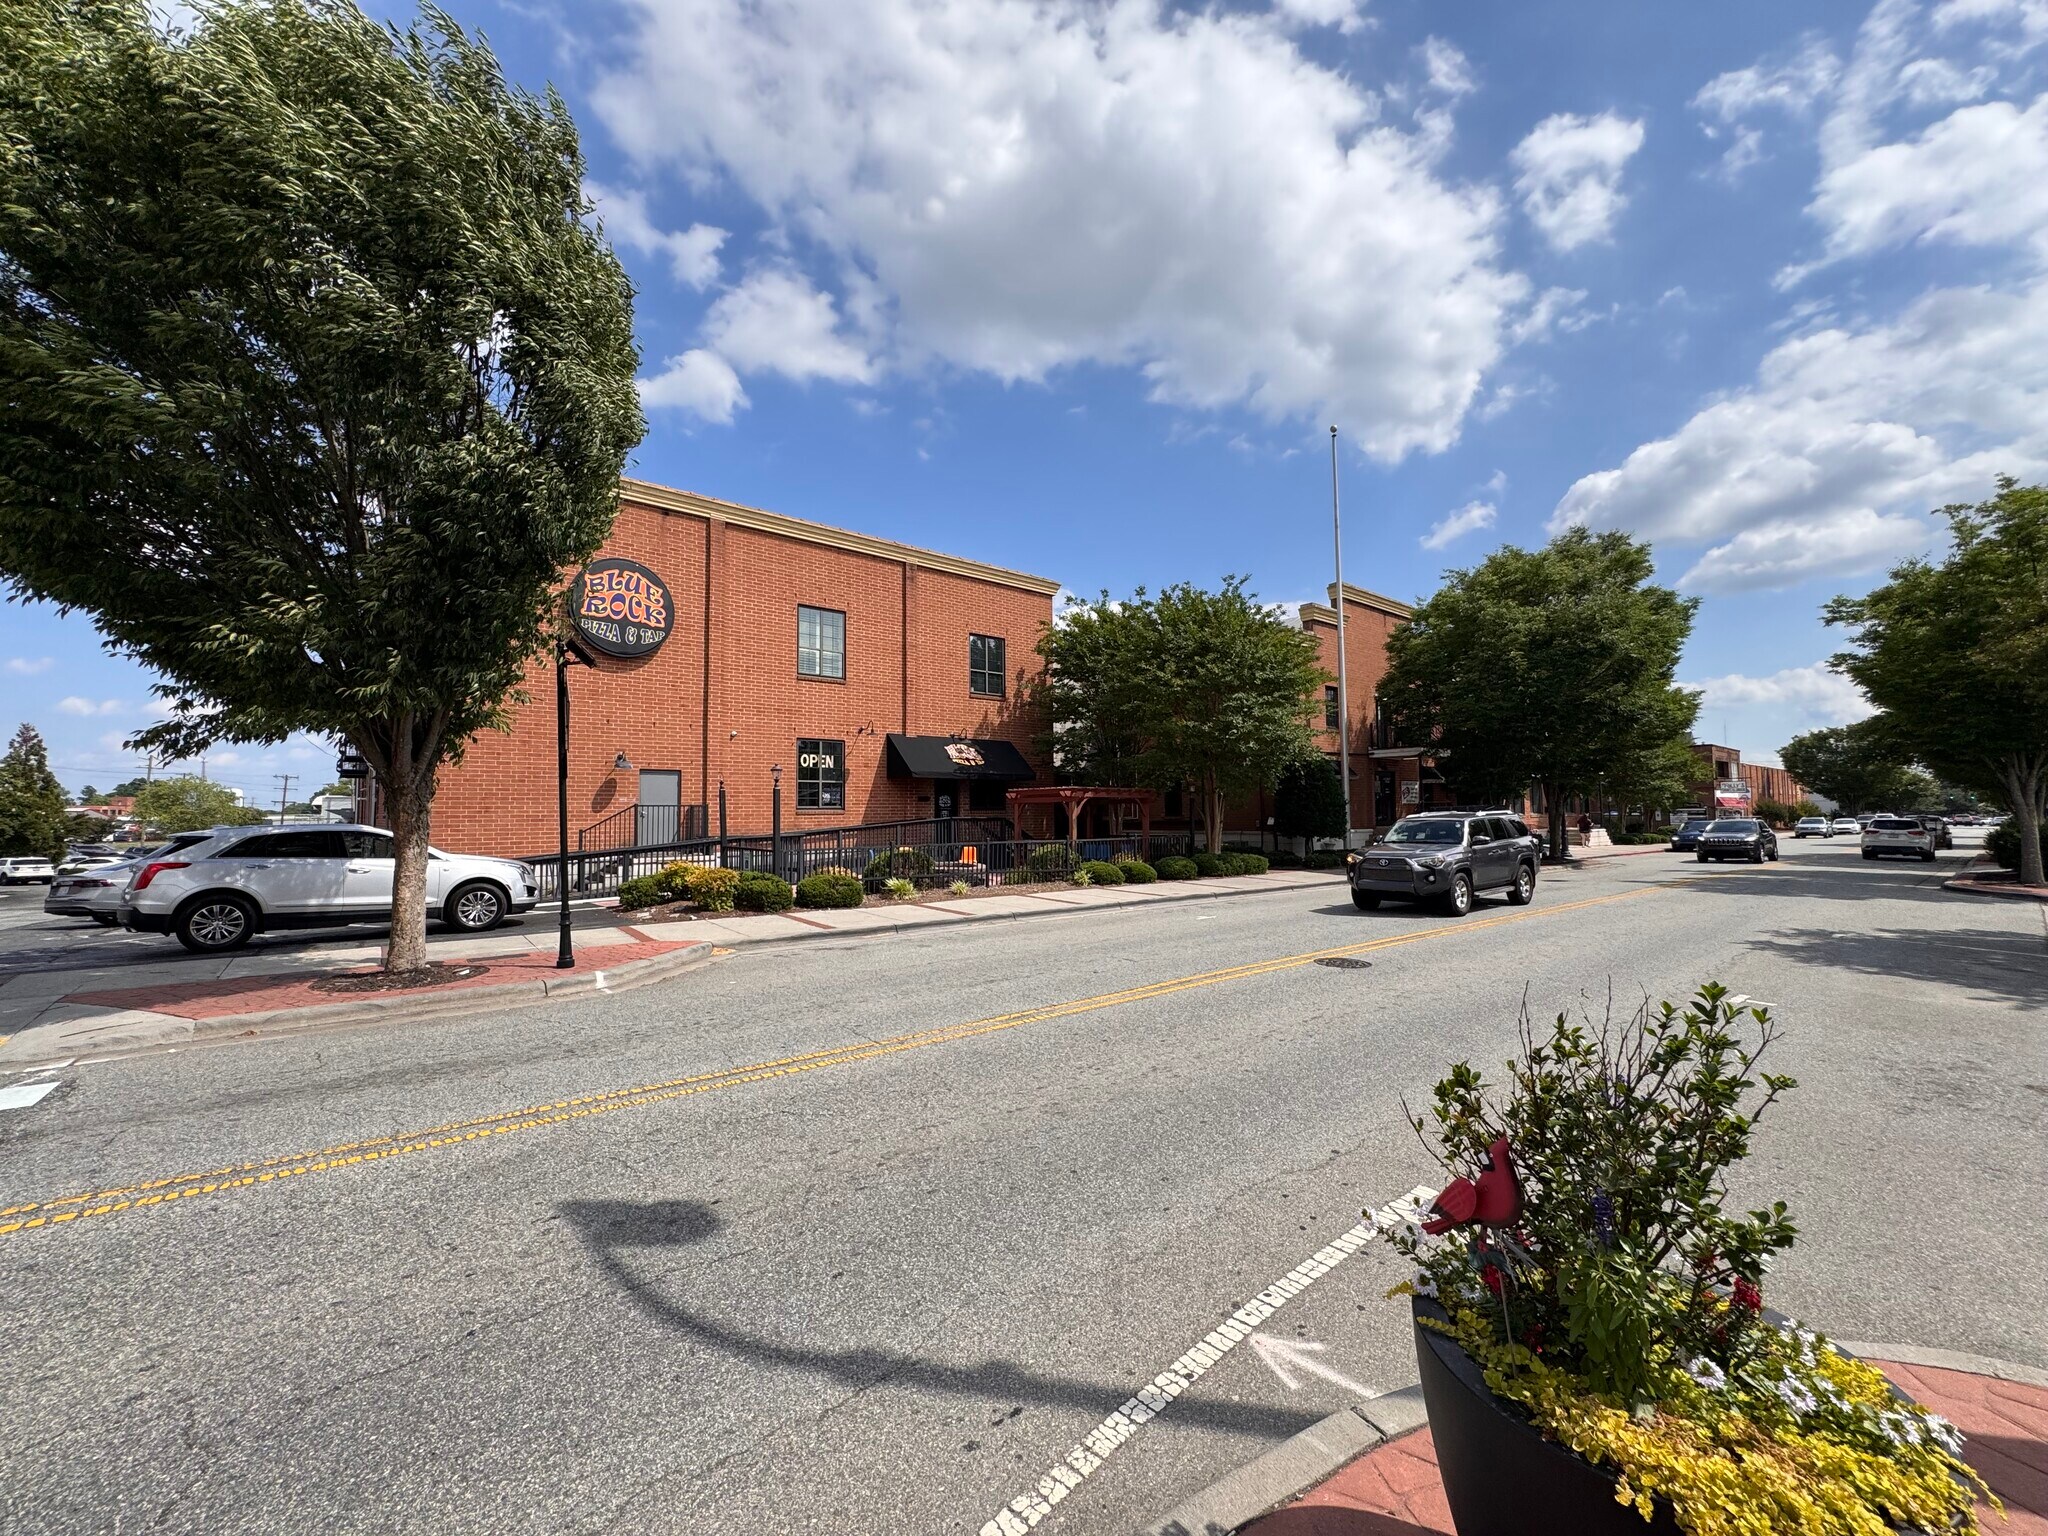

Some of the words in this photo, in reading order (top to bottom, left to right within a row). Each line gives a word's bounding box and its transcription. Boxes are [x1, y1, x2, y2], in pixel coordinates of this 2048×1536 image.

[585, 570, 663, 605] BLUE
[582, 592, 666, 626] ROCK
[581, 618, 621, 643] PIZZA
[625, 626, 637, 645] &
[641, 628, 666, 644] TAP
[800, 754, 834, 768] OPEN
